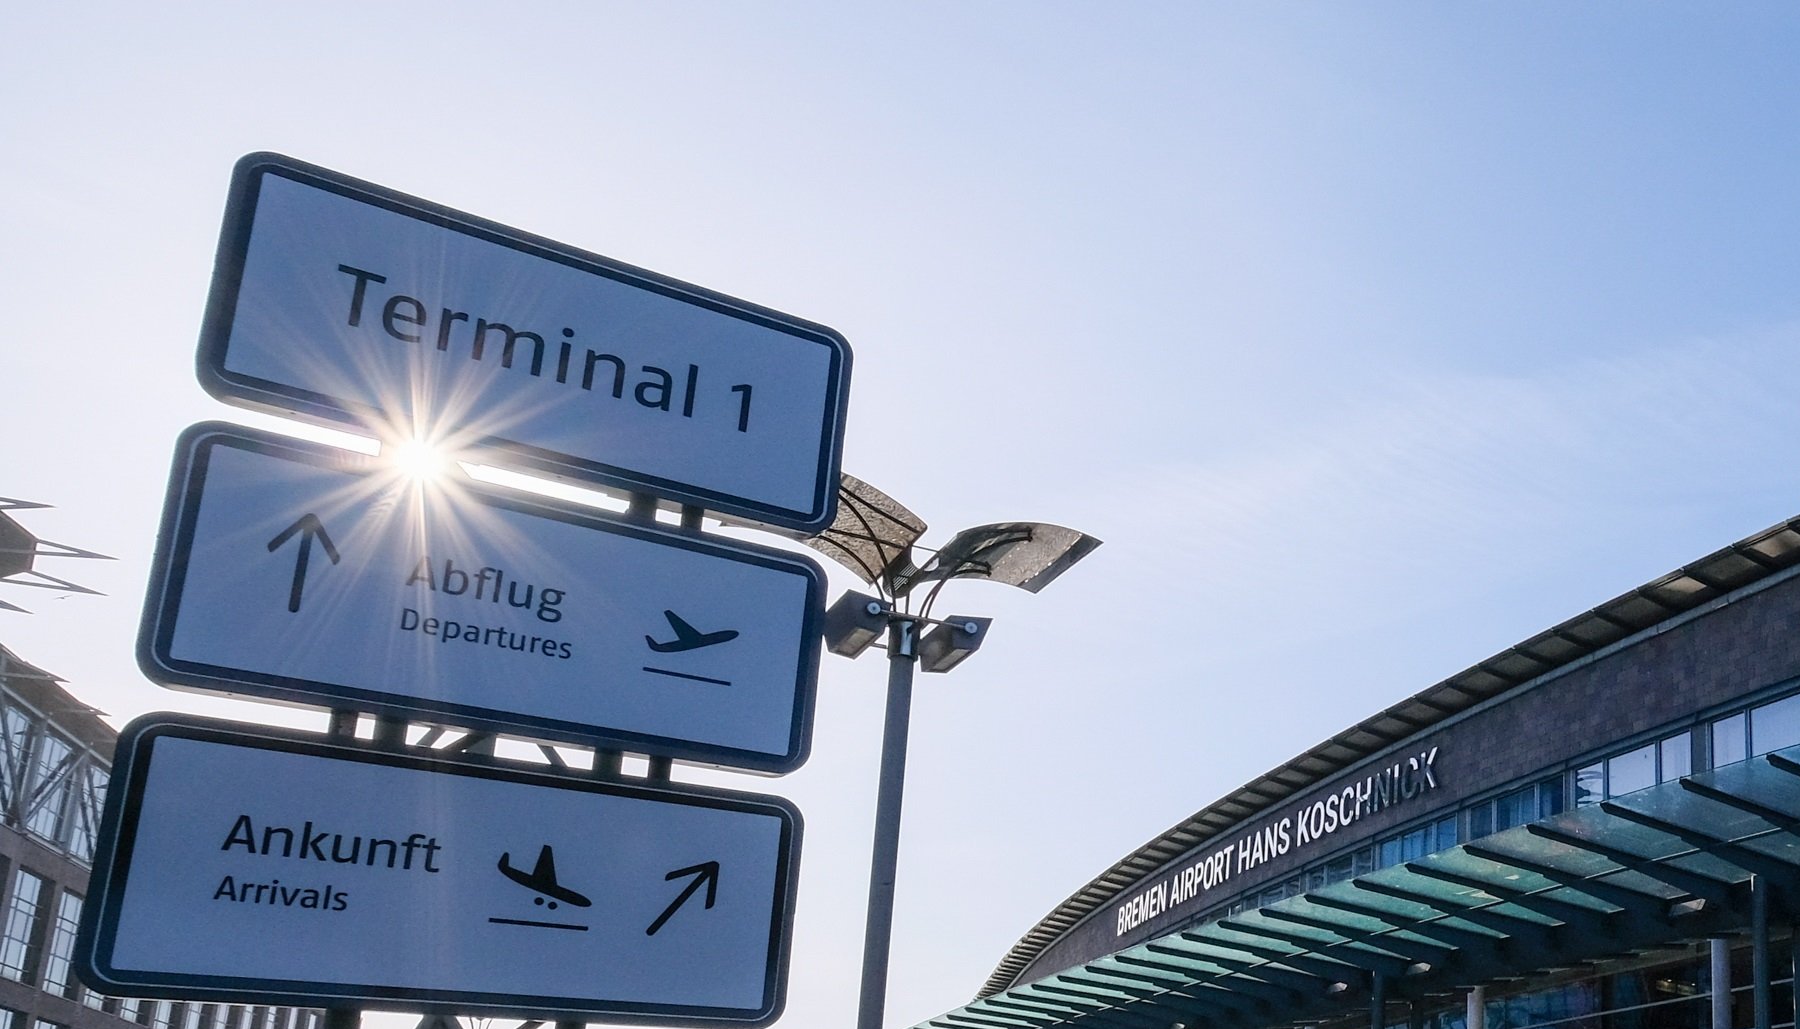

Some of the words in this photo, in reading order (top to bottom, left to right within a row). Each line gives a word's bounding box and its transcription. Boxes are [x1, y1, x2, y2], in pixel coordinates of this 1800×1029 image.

[337, 264, 700, 419] Terminal
[731, 383, 754, 433] 1
[406, 553, 567, 624] Abflug
[400, 607, 574, 663] Departures
[221, 814, 443, 874] Ankunft
[1117, 881, 1168, 937] BREMEN
[1169, 844, 1235, 909] AIRPORT
[1238, 816, 1291, 872] HANS
[1296, 746, 1439, 848] KOSCHNICK
[213, 875, 350, 914] Arrivals
